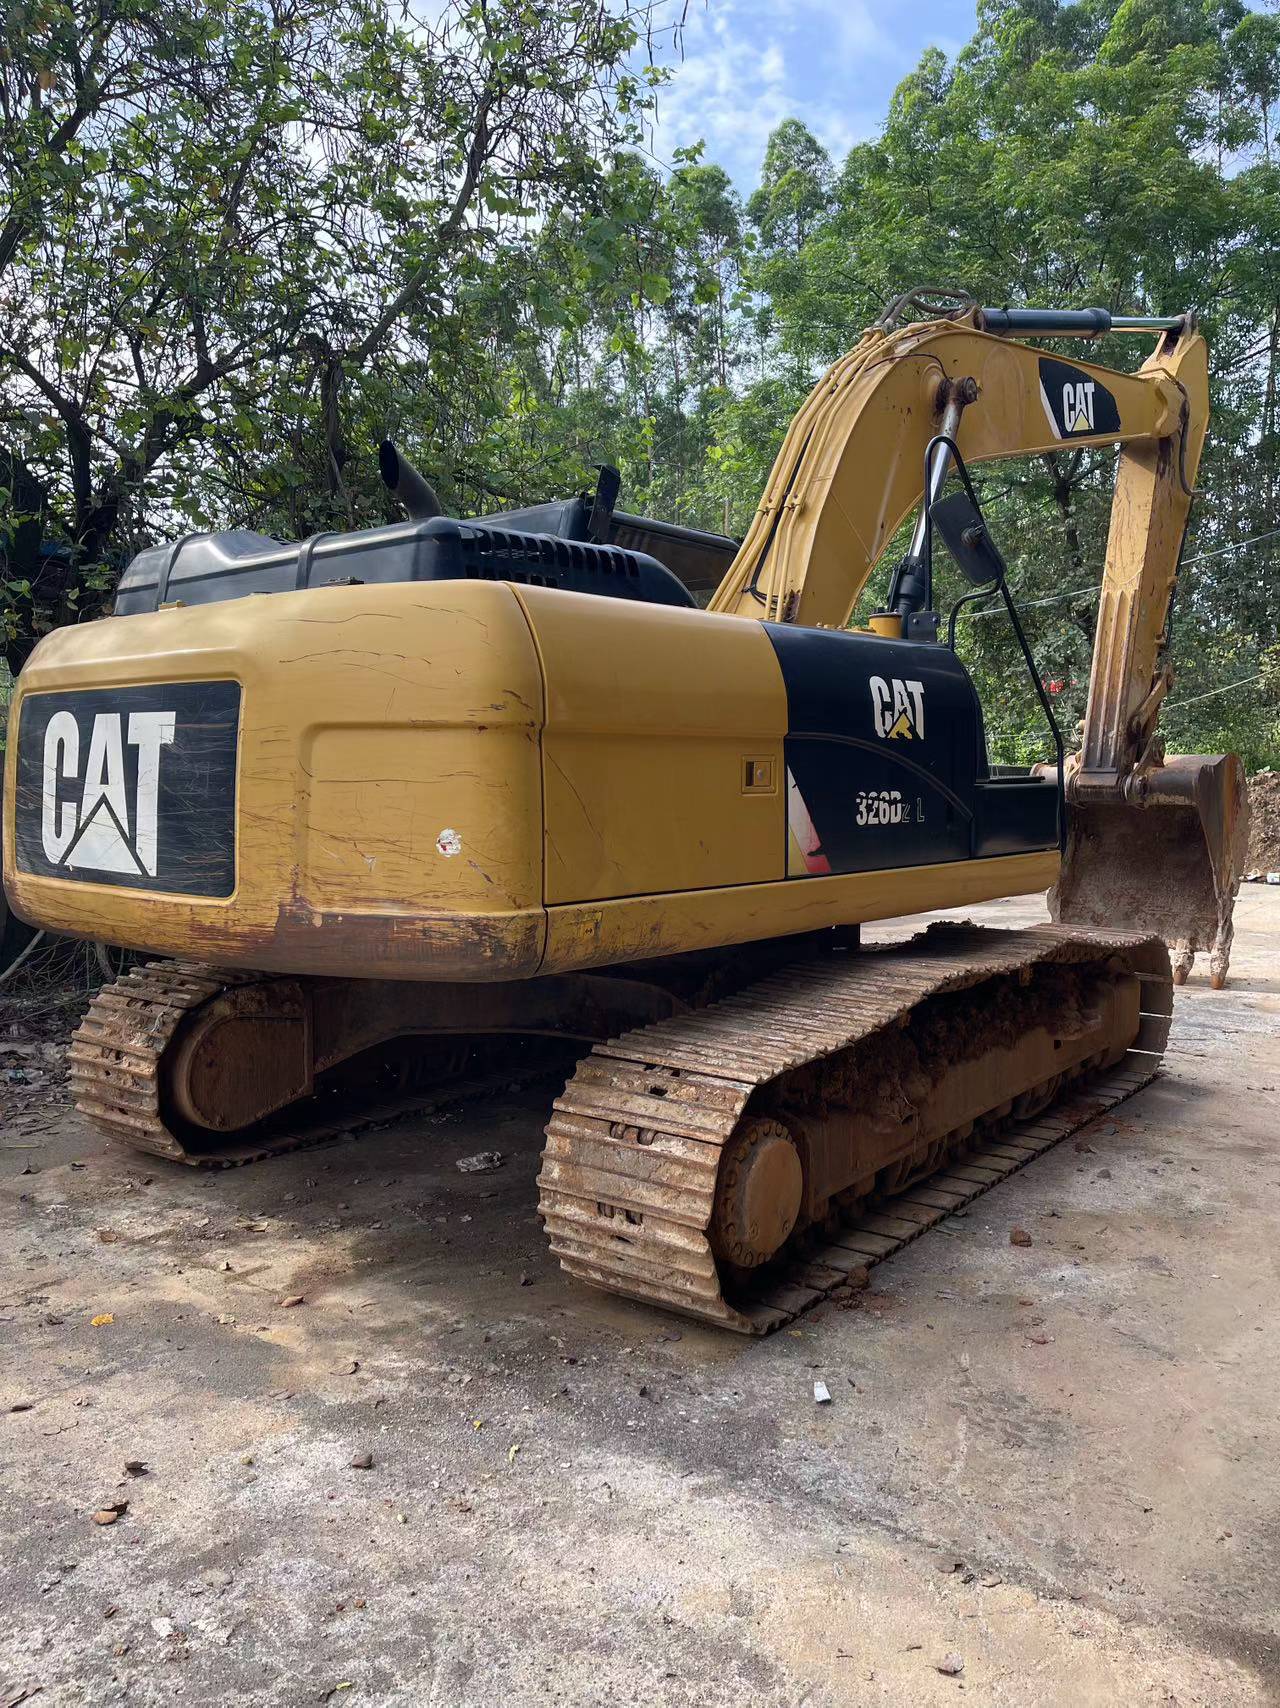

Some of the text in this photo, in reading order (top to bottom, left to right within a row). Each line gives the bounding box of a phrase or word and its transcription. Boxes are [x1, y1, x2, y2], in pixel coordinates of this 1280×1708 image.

[1062, 382, 1095, 432] CAT
[869, 675, 925, 740] CAT
[41, 710, 176, 876] CAT
